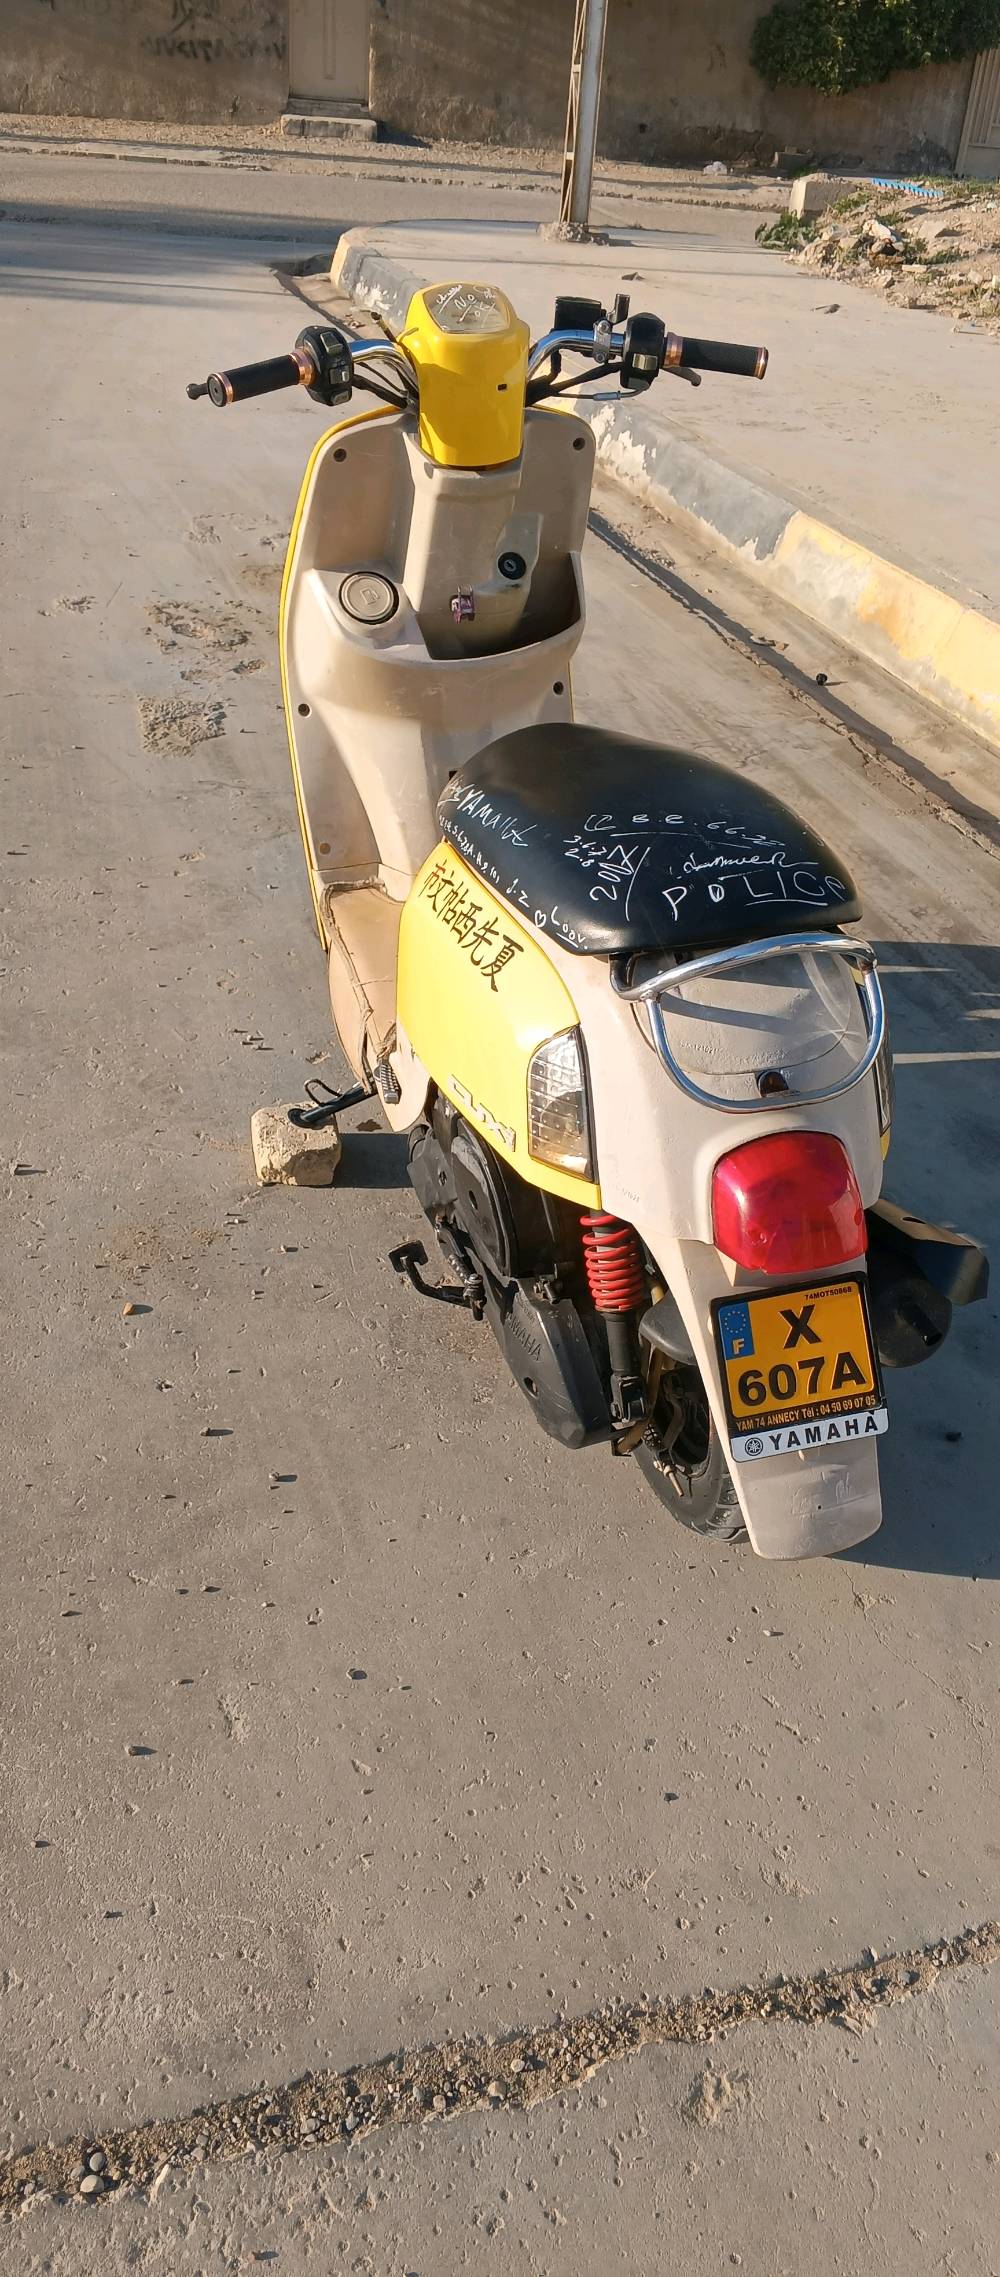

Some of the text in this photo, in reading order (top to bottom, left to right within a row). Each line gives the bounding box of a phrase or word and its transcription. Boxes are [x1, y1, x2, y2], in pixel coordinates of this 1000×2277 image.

[778, 1303, 822, 1350] X
[732, 1337, 745, 1356] F
[737, 1351, 868, 1408] 607A
[736, 1420, 755, 1432] YAM
[755, 1417, 766, 1428] 74
[767, 1409, 801, 1427] ANNECY
[801, 1406, 815, 1420] Tél
[820, 1403, 831, 1416] 04
[831, 1401, 842, 1413] 50
[854, 1396, 865, 1409] 07
[768, 1415, 879, 1451] YAMAHA
